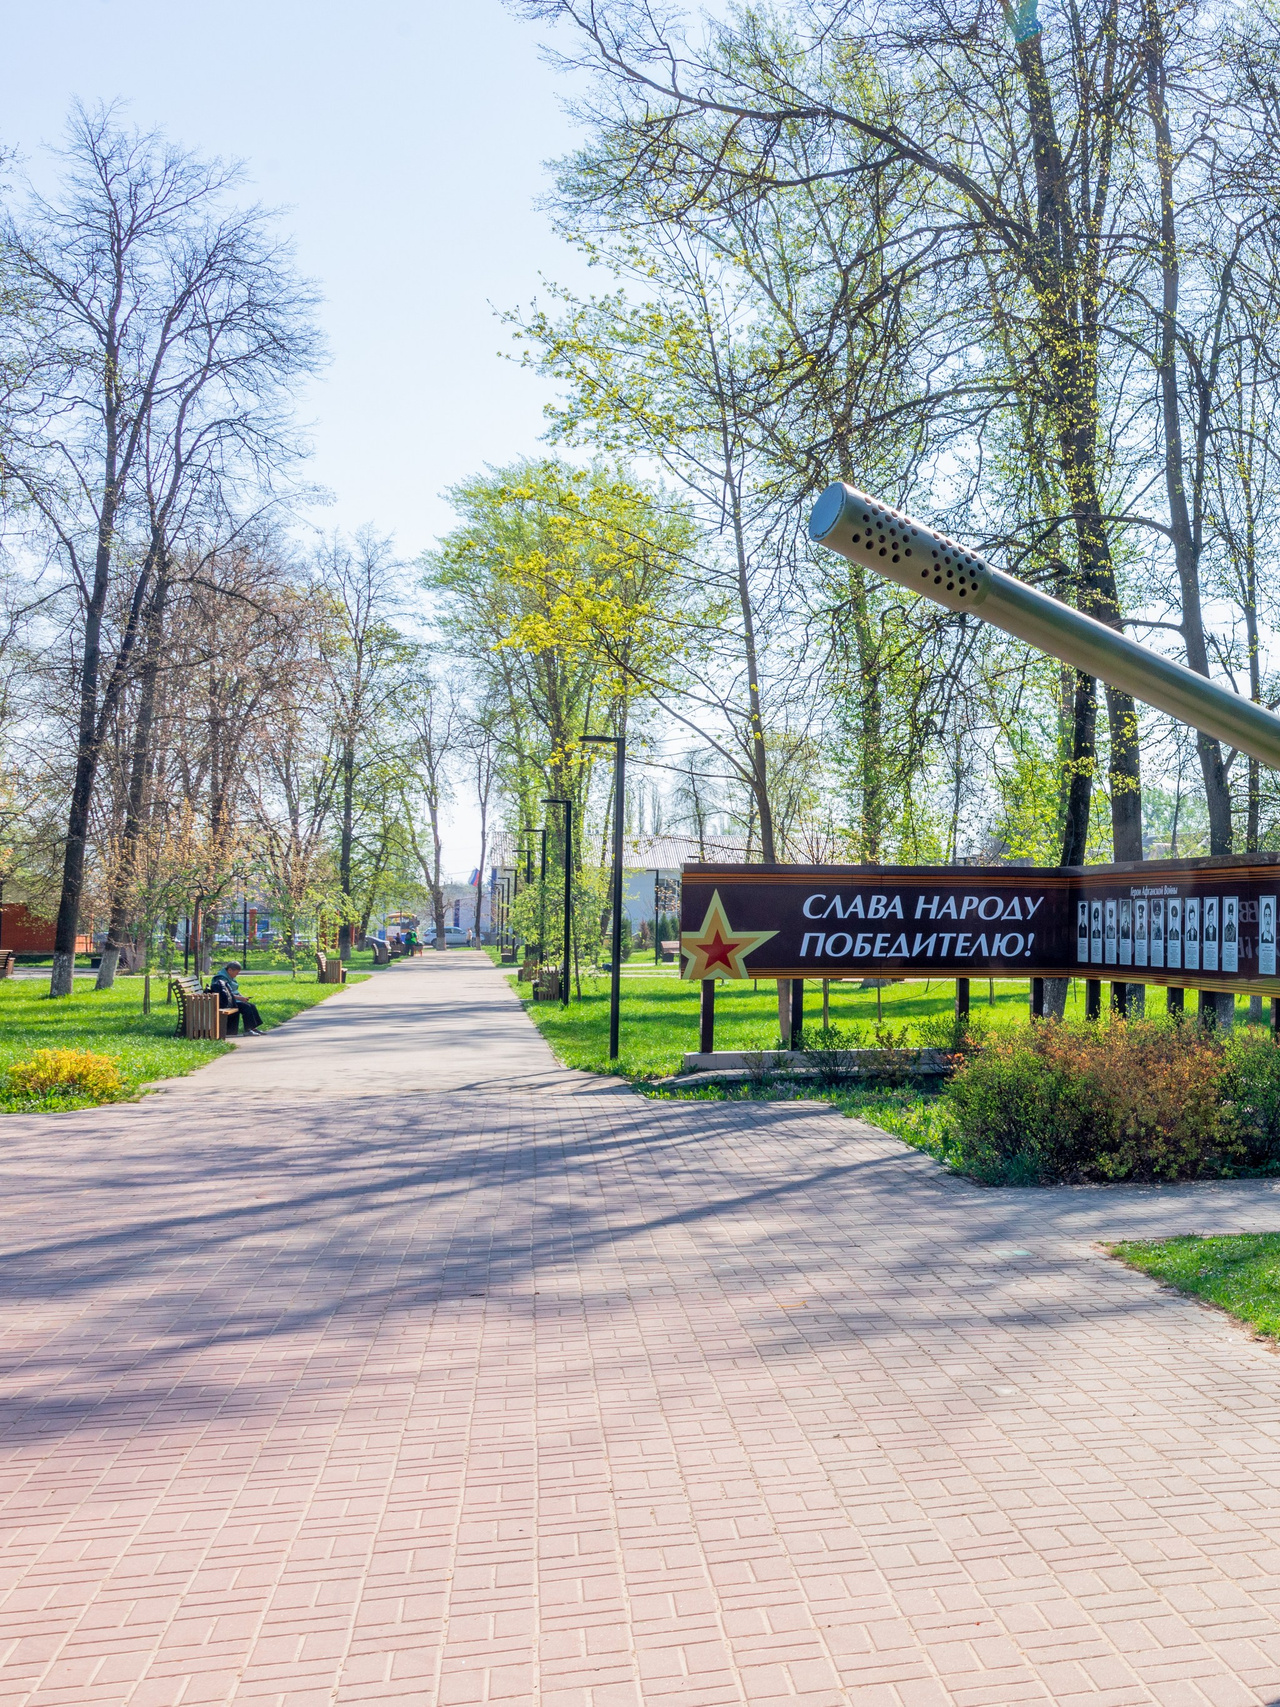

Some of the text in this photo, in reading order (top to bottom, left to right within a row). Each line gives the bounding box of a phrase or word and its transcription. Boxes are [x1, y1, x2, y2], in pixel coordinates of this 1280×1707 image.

[1142, 885, 1163, 898] Афганской
[802, 894, 1045, 921] СЛАВА НАРОДУ
[799, 932, 1036, 958] ПОБЕДИТЕЛЮ!
